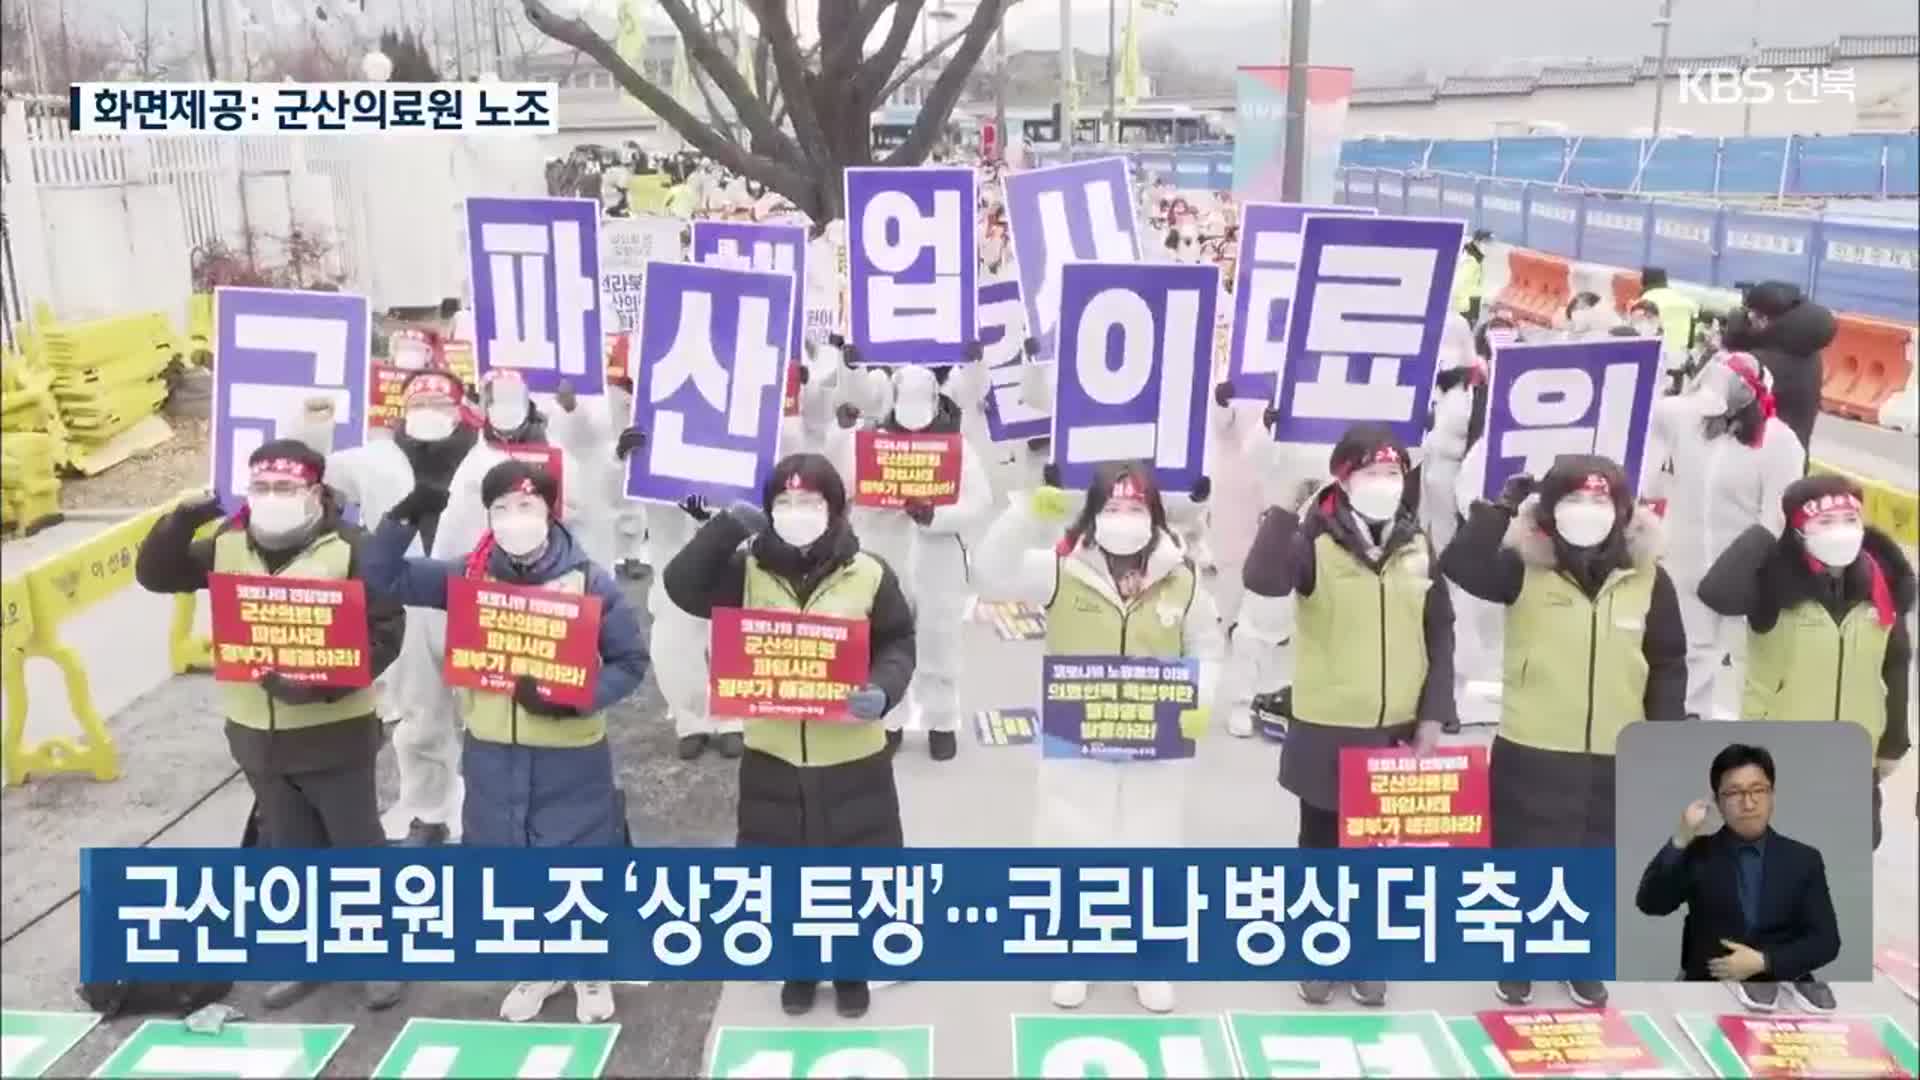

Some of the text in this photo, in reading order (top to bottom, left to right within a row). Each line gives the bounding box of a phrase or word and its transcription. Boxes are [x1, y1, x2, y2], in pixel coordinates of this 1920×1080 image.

[482, 221, 594, 374] 파
[863, 189, 961, 343] 업
[1076, 288, 1200, 469] 의
[1292, 245, 1439, 421] 료
[650, 291, 779, 488] 산
[240, 602, 333, 625] 군산의료원
[479, 608, 567, 639] 군산의료원
[744, 635, 837, 660] 군산의료원
[718, 678, 773, 698] 정부가
[1370, 772, 1460, 794] 군산의료원
